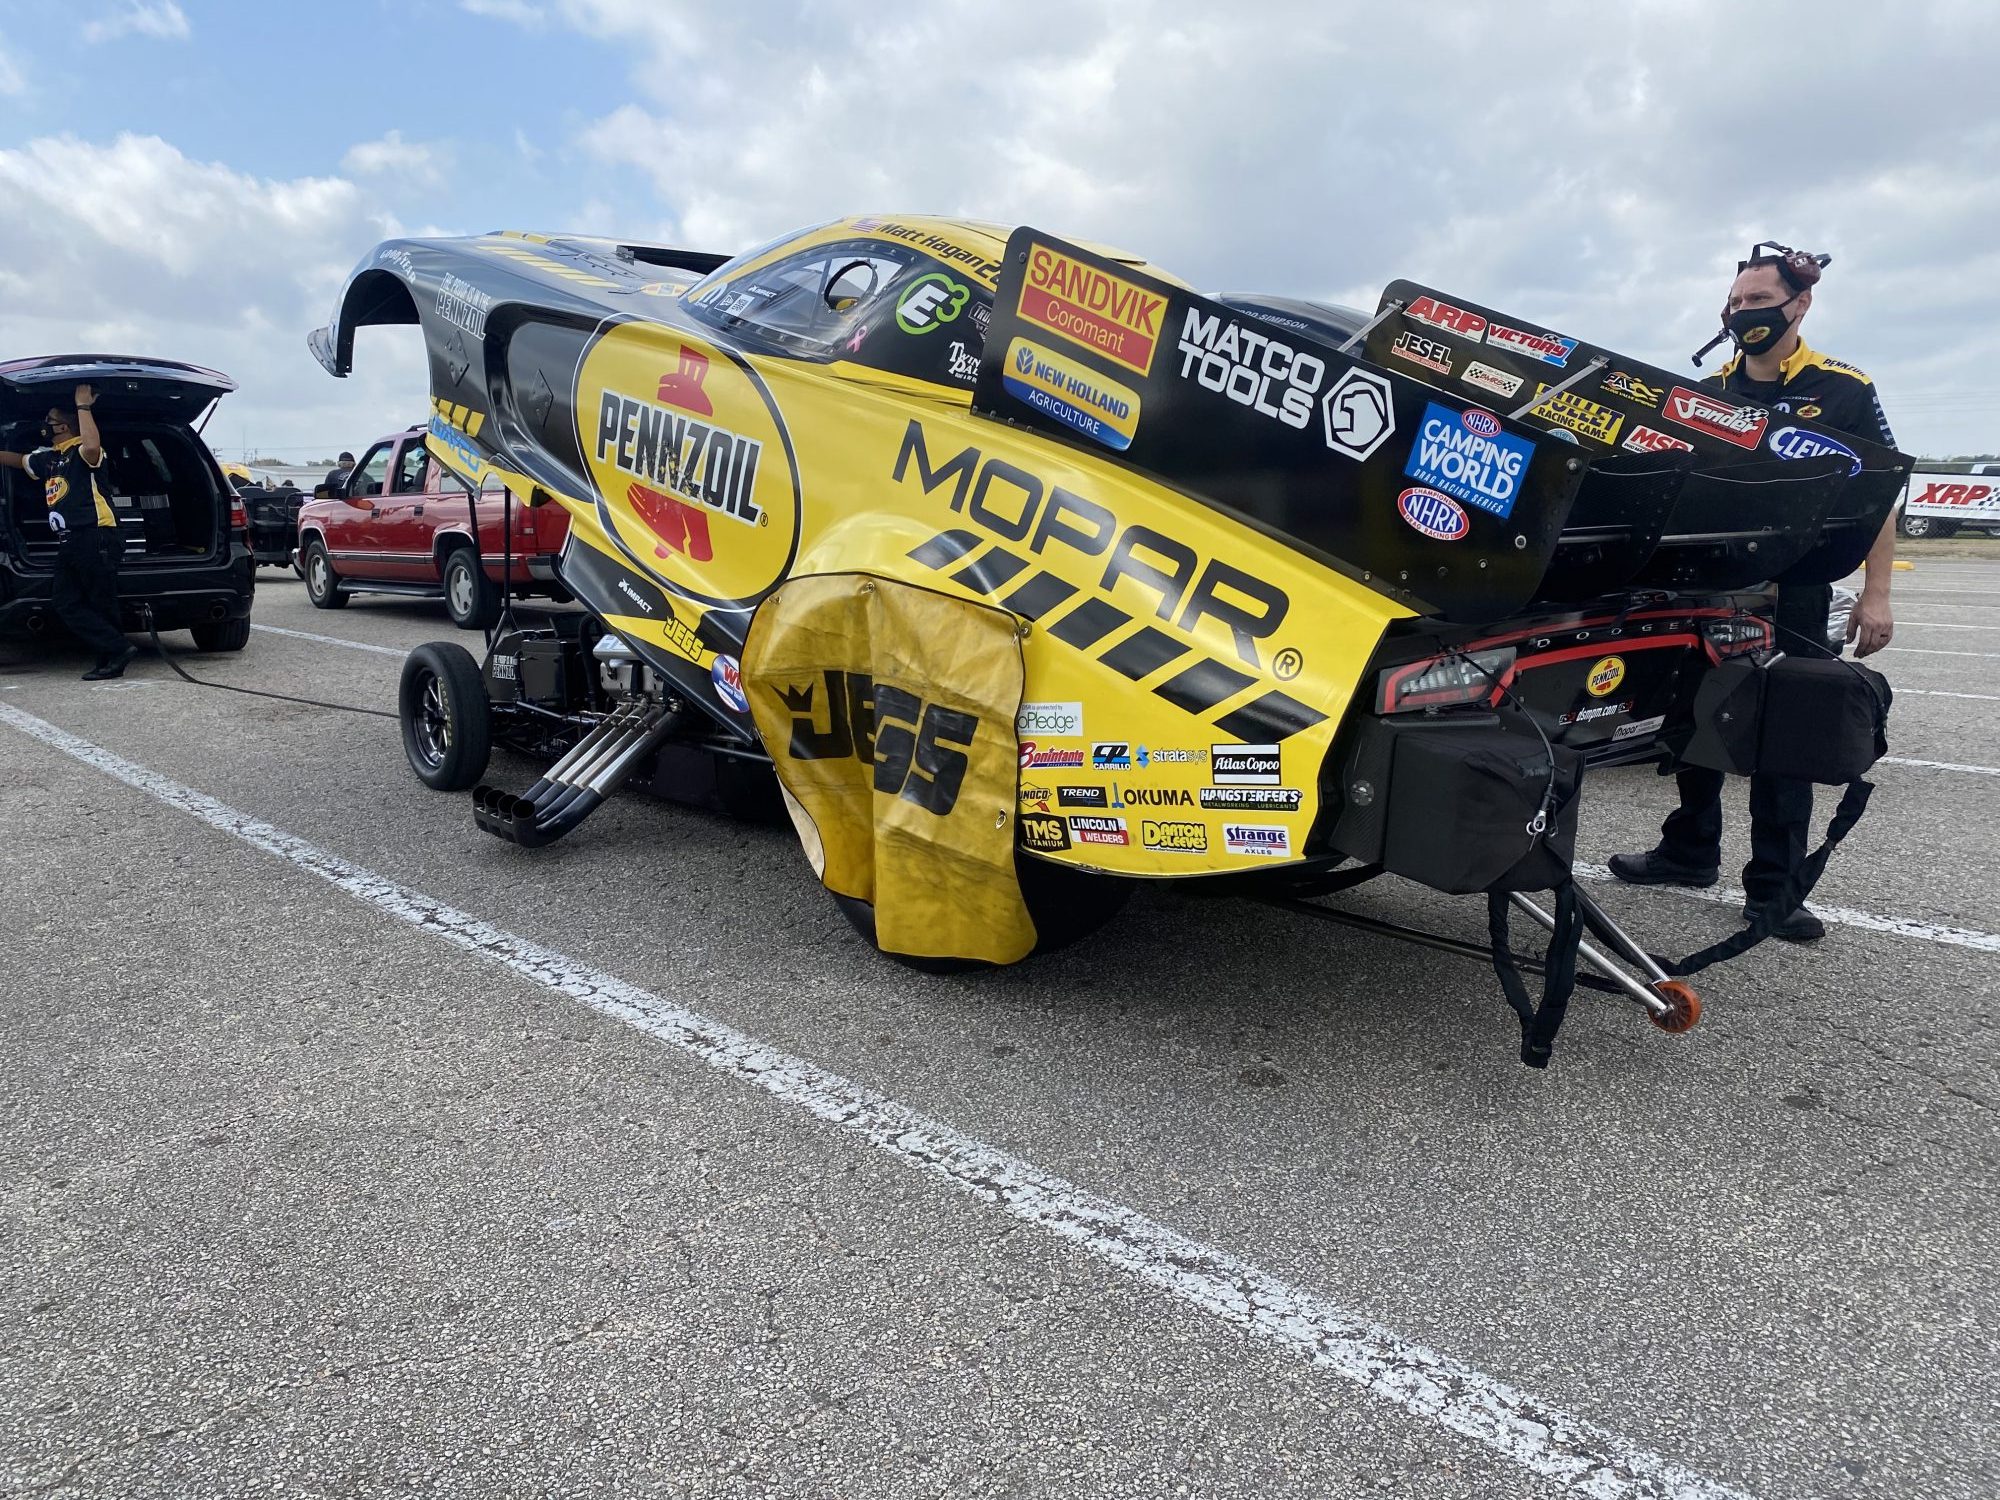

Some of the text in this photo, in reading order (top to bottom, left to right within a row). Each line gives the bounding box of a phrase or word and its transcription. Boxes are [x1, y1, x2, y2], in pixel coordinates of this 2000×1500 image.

[876, 224, 925, 243] Matt
[920, 235, 985, 268] Hagan
[379, 249, 416, 284] GOODYEAR
[1030, 250, 1162, 337] SANDVIK
[435, 287, 487, 340] PENNZOIL
[1046, 300, 1125, 353] Coromant
[1259, 313, 1309, 329] SIMPSON
[1407, 296, 1487, 335] ARP
[1181, 306, 1326, 394] MATCO
[1394, 331, 1452, 368] JESEL
[1490, 325, 1569, 357] VICTORY
[948, 359, 979, 376] PAL
[1035, 360, 1130, 420] NEW HOLLAND
[1177, 339, 1314, 430] TOOLS
[1029, 390, 1100, 435] AGRICULTURE
[1466, 414, 1496, 434] NHRA
[1538, 408, 1575, 428] RACING
[1577, 422, 1608, 440] CAMS
[1674, 396, 1759, 434] Sander
[596, 388, 764, 527] PENNZOIL
[1424, 419, 1523, 476] CAMPING
[1419, 439, 1513, 499] WORLD
[1413, 468, 1504, 514] DRAG RACING SERIES
[1414, 488, 1462, 512] CHAMPIONSHIP
[1912, 483, 1992, 505] XRP
[1408, 495, 1458, 532] NHRA
[892, 418, 1290, 670] MOPAR
[626, 587, 653, 613] IMPACT
[663, 617, 704, 662] JEGS
[1536, 622, 1679, 648] DODGE
[492, 664, 516, 680] PENNZO
[1591, 667, 1620, 687] PENNZOIL
[1018, 711, 1074, 733] oPledge
[789, 669, 979, 816] JEGS
[1094, 745, 1128, 764] CP
[1152, 749, 1208, 764] stratasys
[1213, 757, 1280, 772] Atlas Copco
[1062, 788, 1100, 797] TREND
[1123, 789, 1195, 806] OKUMA
[1200, 788, 1301, 803] HANGSTERFER'S
[1023, 819, 1063, 841] TMS
[1070, 817, 1118, 832] LINCOLN
[1085, 832, 1125, 844] WELDERS
[1226, 826, 1286, 843] Strange
[1026, 839, 1064, 848] TITANIUM
[1160, 834, 1207, 850] SLEEVES
